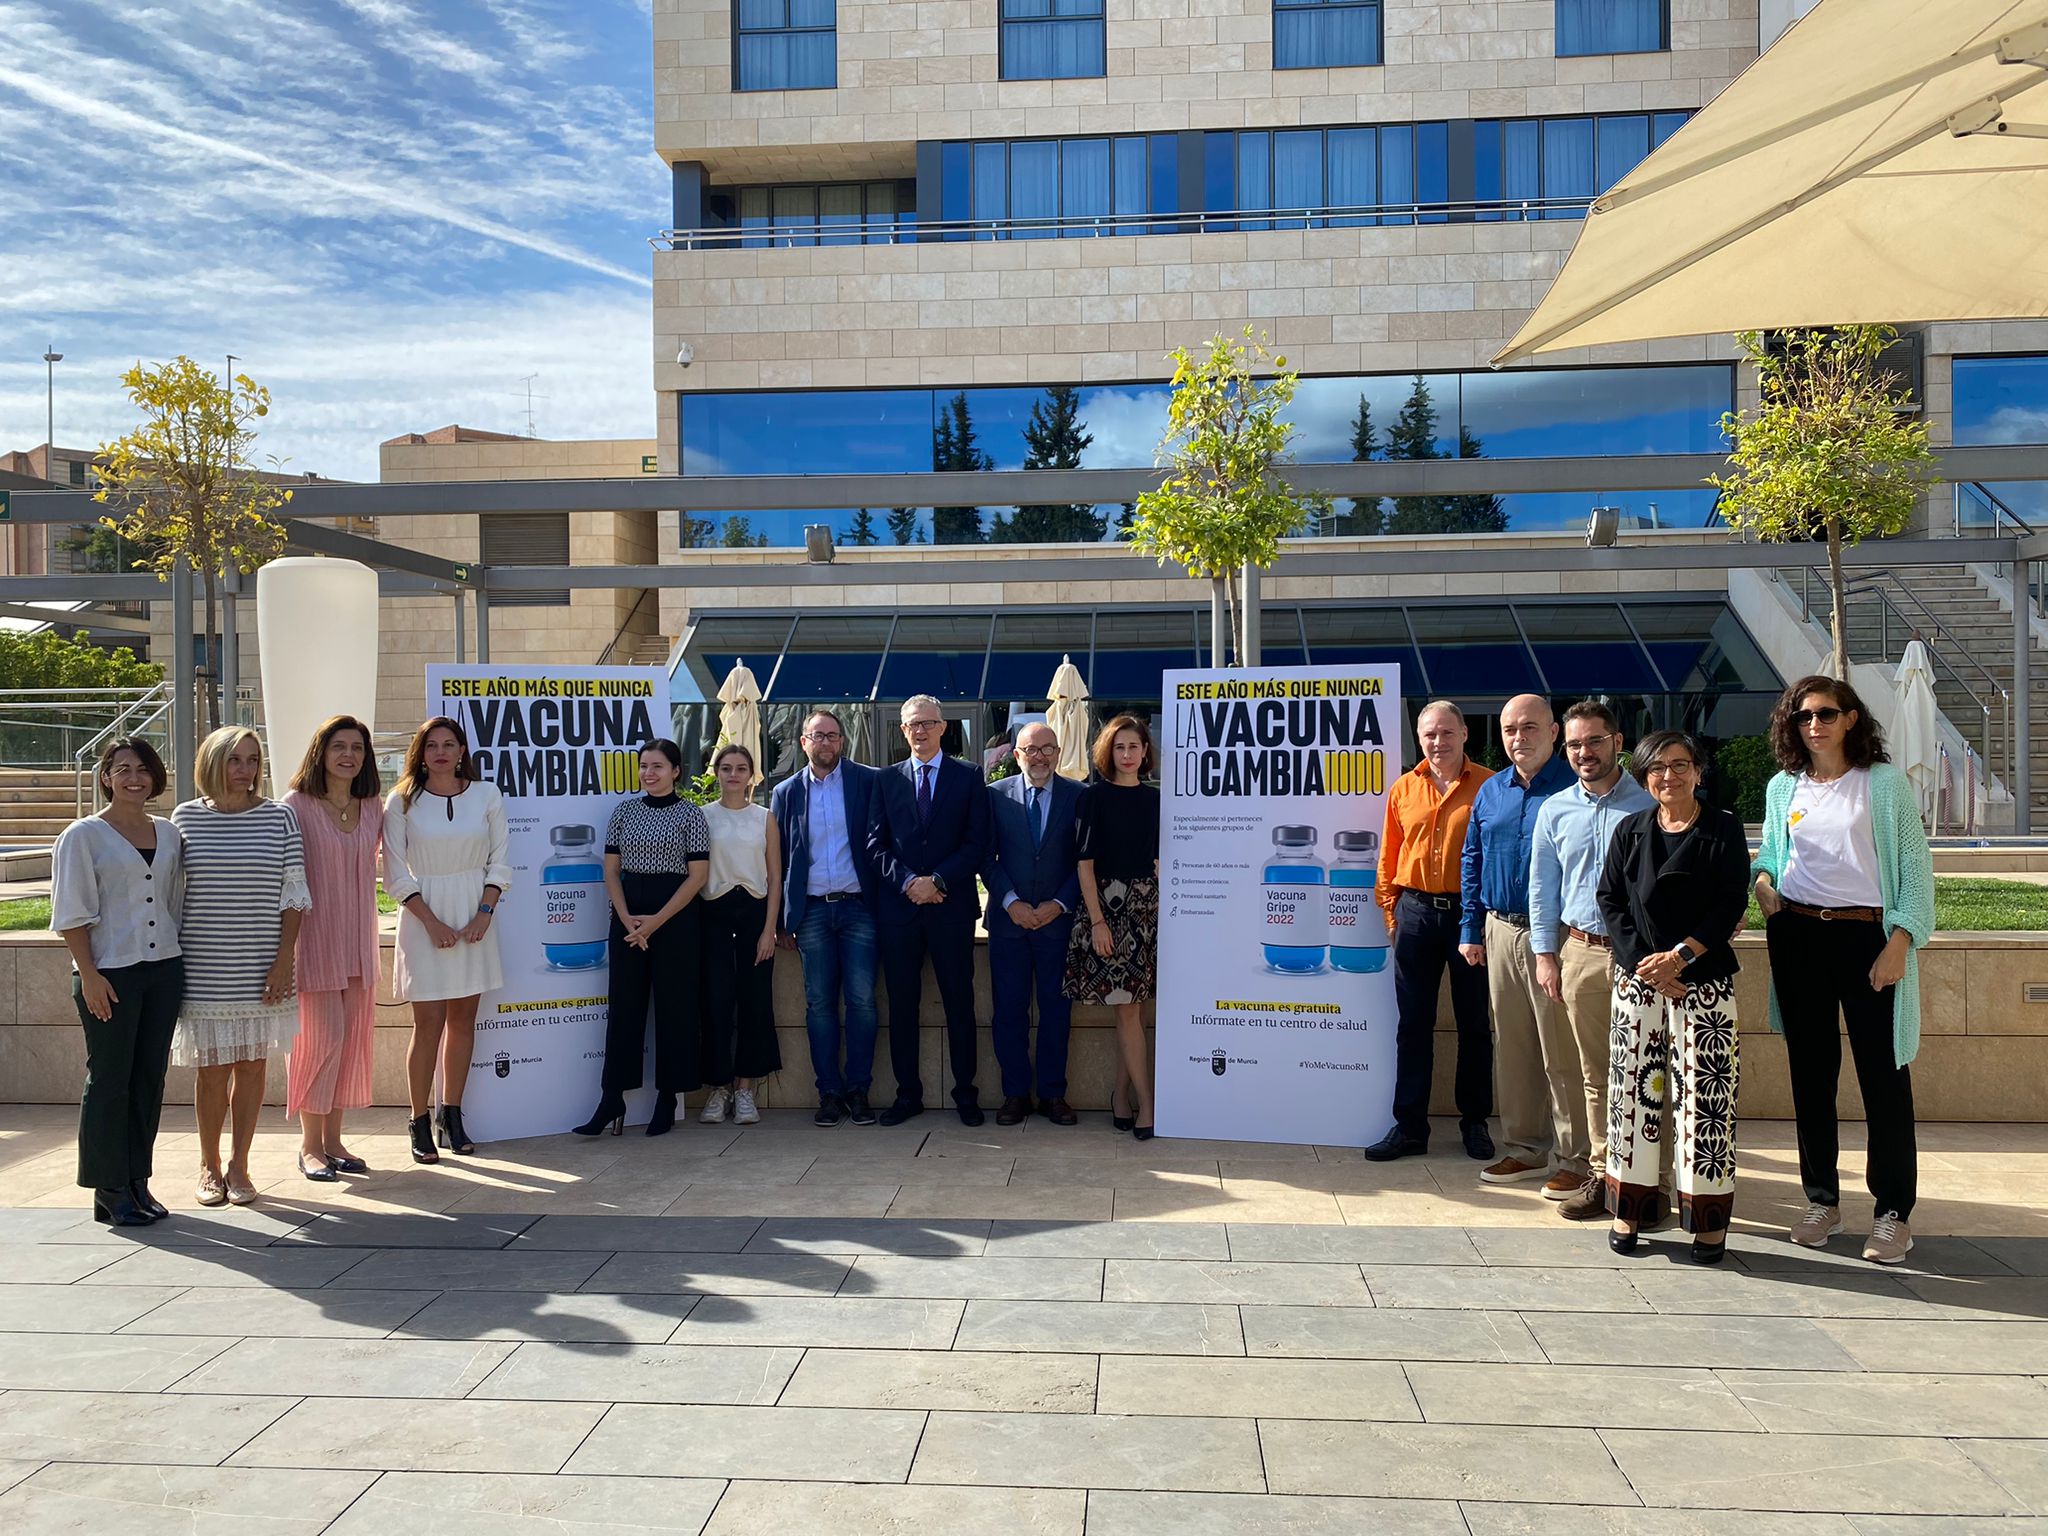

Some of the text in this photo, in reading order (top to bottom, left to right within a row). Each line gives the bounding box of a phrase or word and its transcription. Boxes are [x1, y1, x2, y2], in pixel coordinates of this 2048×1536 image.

[441, 676, 653, 698] ESTE AÑO MÁS QUE NUNCA
[1177, 678, 1382, 700] ESTE AÑO MÁS QUE NUNCA
[468, 699, 655, 748] VACUNA
[1175, 699, 1384, 748] LA VACUNA
[600, 749, 642, 795] TOD
[1174, 749, 1384, 797] LO CAMBIA TODO
[507, 816, 541, 824] erteneces
[1173, 815, 1220, 823] Especialmente
[522, 825, 532, 833] de
[1188, 824, 1221, 832] siguientes
[546, 889, 587, 900] Vacuna
[1266, 890, 1307, 901] Vacuna
[1328, 892, 1368, 903] Vacuna
[546, 901, 576, 913] Gripe
[1266, 902, 1296, 914] Gripe
[1328, 903, 1359, 914] Covid
[547, 912, 575, 924] 2022
[1266, 914, 1294, 925] 2022
[1328, 916, 1356, 926] 2022
[497, 1003, 513, 1014] La
[515, 1000, 558, 1012] vacuna
[561, 1000, 574, 1010] es
[1216, 1000, 1342, 1015] La vacuna es gratuita
[474, 1017, 529, 1032] nfórmate
[531, 1016, 546, 1026] en
[548, 1014, 561, 1025] tu
[562, 1012, 598, 1024] centro
[1190, 1014, 1368, 1031] Infórmate en tu centro de salud
[472, 1056, 542, 1069] Región de Murcia
[1188, 1056, 1258, 1066] Región de Murcia
[1299, 1060, 1369, 1072] #YoMeVacunoRM
